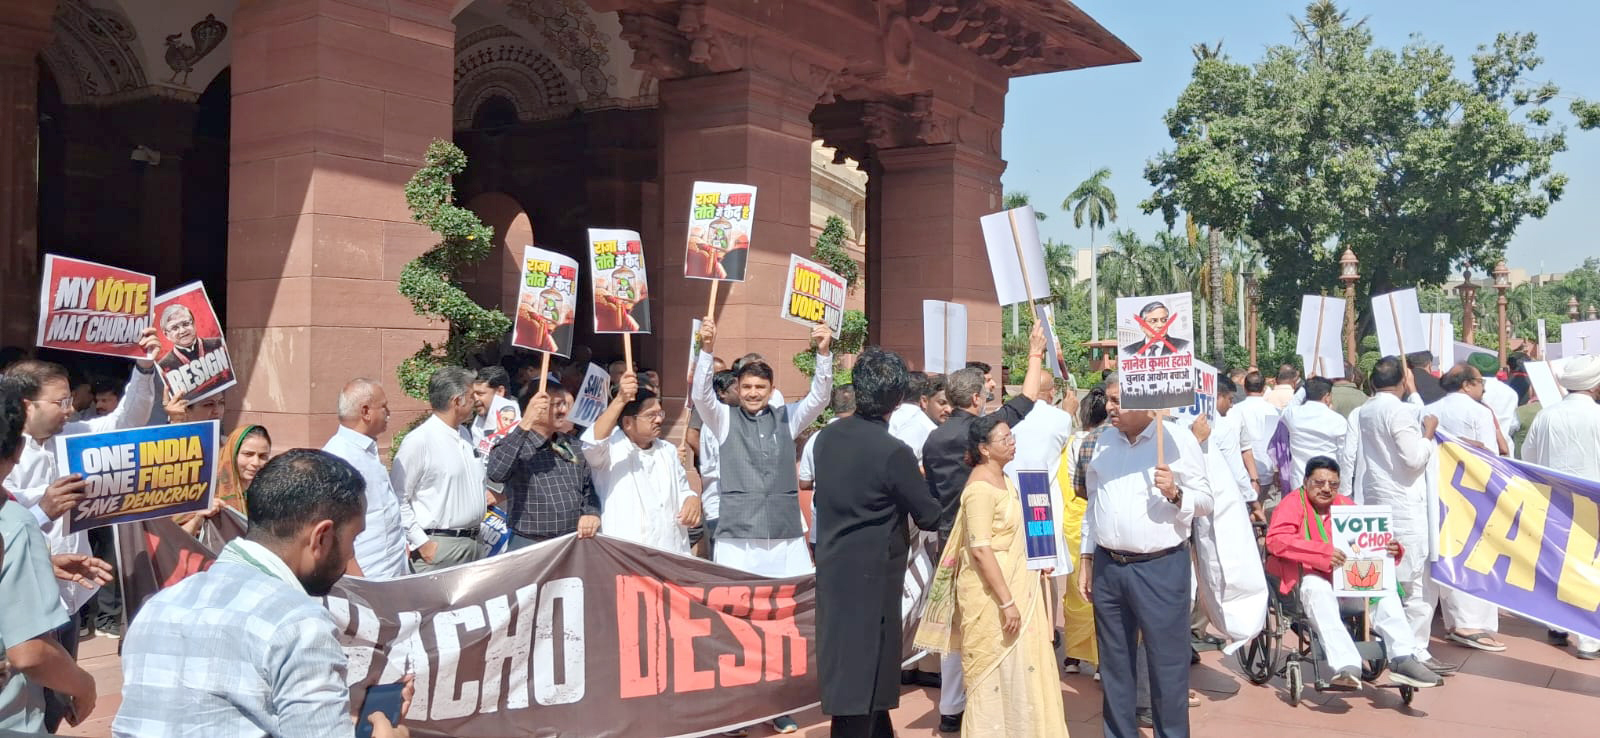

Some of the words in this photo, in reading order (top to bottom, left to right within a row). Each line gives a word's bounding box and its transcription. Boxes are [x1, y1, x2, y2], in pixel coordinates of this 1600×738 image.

[54, 276, 95, 310] MY
[95, 277, 149, 315] VOTE
[794, 267, 821, 298] VOTE
[790, 293, 826, 322] VOICE
[47, 314, 88, 342] MAT
[165, 347, 229, 396] RESIGN
[1121, 356, 1147, 372] ज्ञानेश
[1148, 356, 1170, 371] कुमार
[1171, 351, 1193, 368] हटाओ
[1126, 374, 1145, 385] चुनाव
[1147, 371, 1169, 382] आयोग
[1170, 368, 1190, 380] बचाओ
[1202, 371, 1215, 395] MY
[81, 443, 136, 474] ONE
[139, 435, 203, 467] INDIA
[84, 469, 136, 499] ONE
[137, 459, 204, 492] FIGHT
[74, 496, 121, 521] SAVE
[119, 482, 208, 511] DEMOCRACY
[1333, 515, 1389, 533] VOTE
[616, 574, 808, 699] DESH
